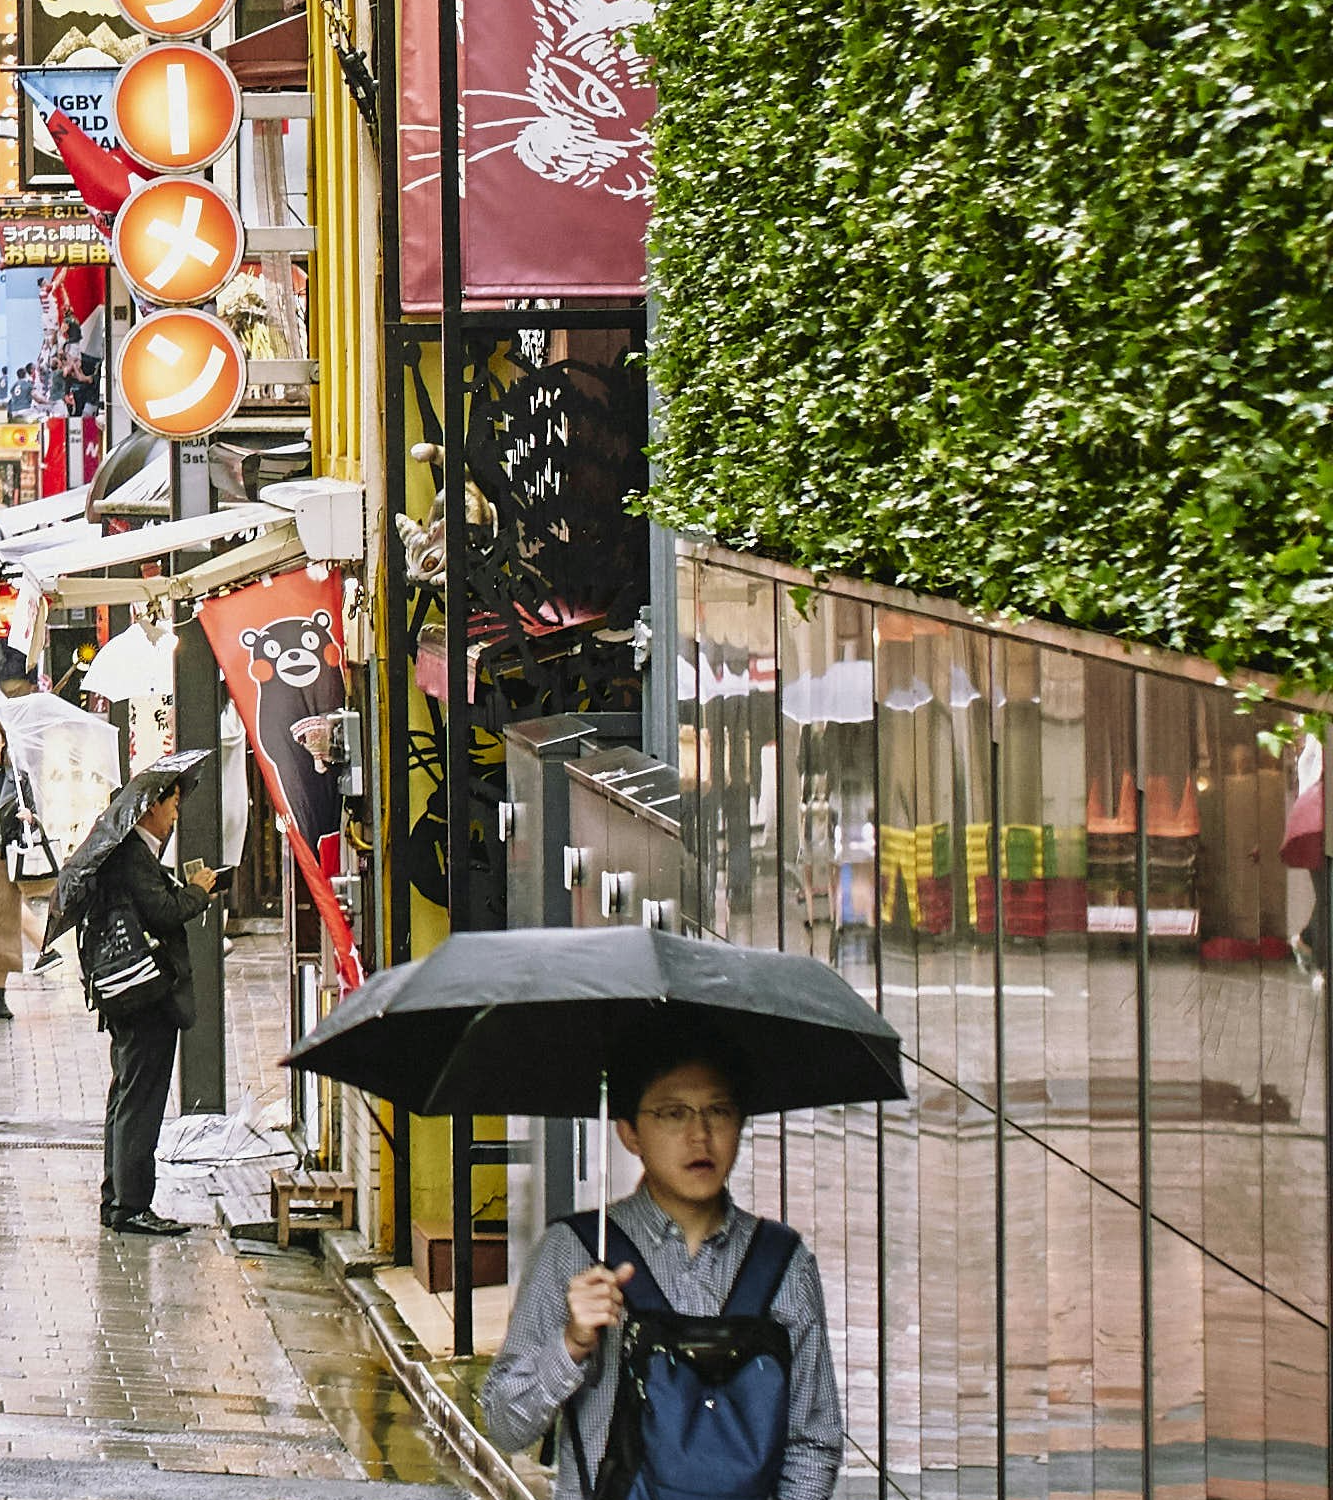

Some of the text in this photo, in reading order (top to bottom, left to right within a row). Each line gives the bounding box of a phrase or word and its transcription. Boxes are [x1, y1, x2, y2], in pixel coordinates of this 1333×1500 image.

[4, 243, 111, 266] お替り自由
[182, 452, 208, 464] 3st.
